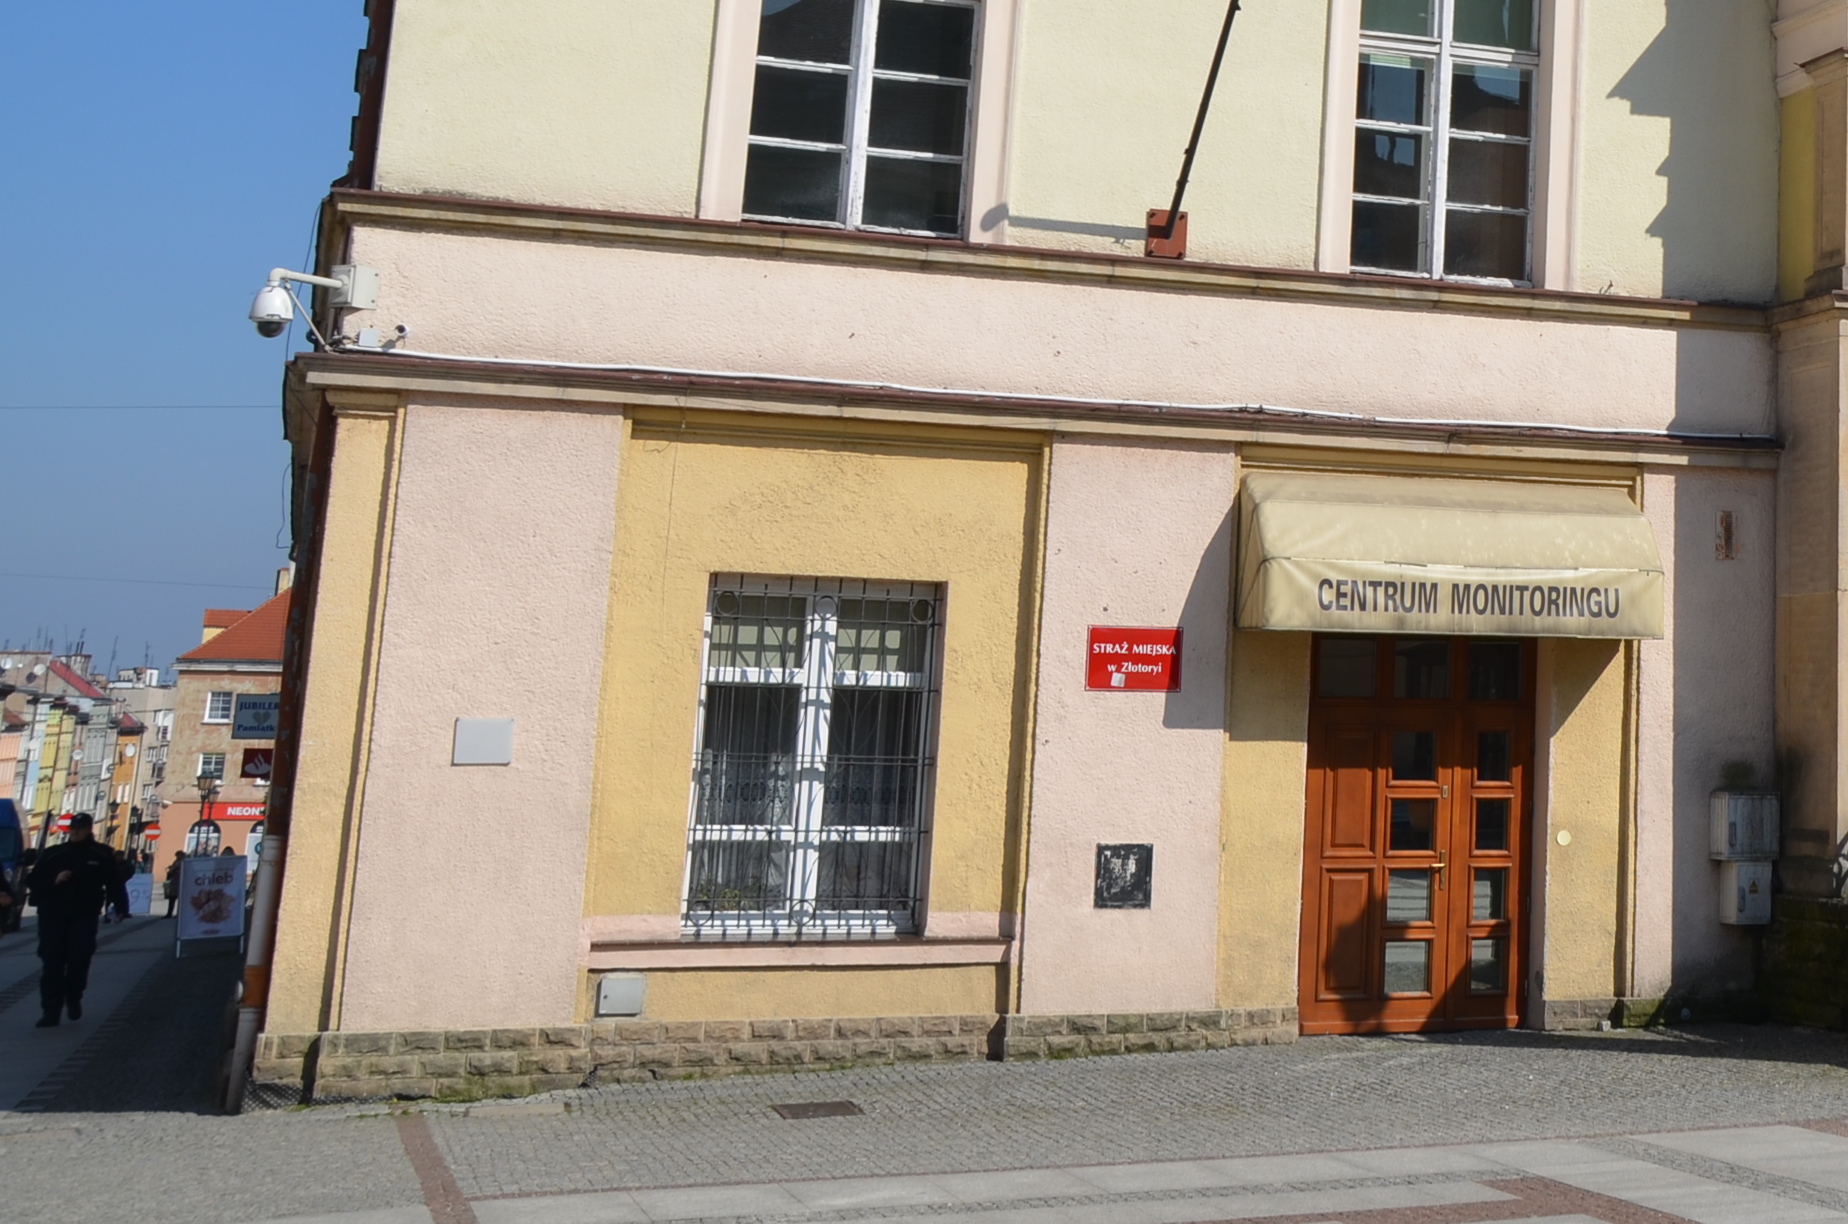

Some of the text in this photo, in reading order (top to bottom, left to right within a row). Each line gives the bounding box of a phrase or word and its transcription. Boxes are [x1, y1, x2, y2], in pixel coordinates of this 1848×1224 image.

[1317, 577, 1621, 619] CENTRUM MONITORINGU
[1092, 641, 1177, 656] STRAŻ MIEJSKA
[1107, 661, 1162, 676] w Złotoryi
[195, 872, 234, 885] chleb
